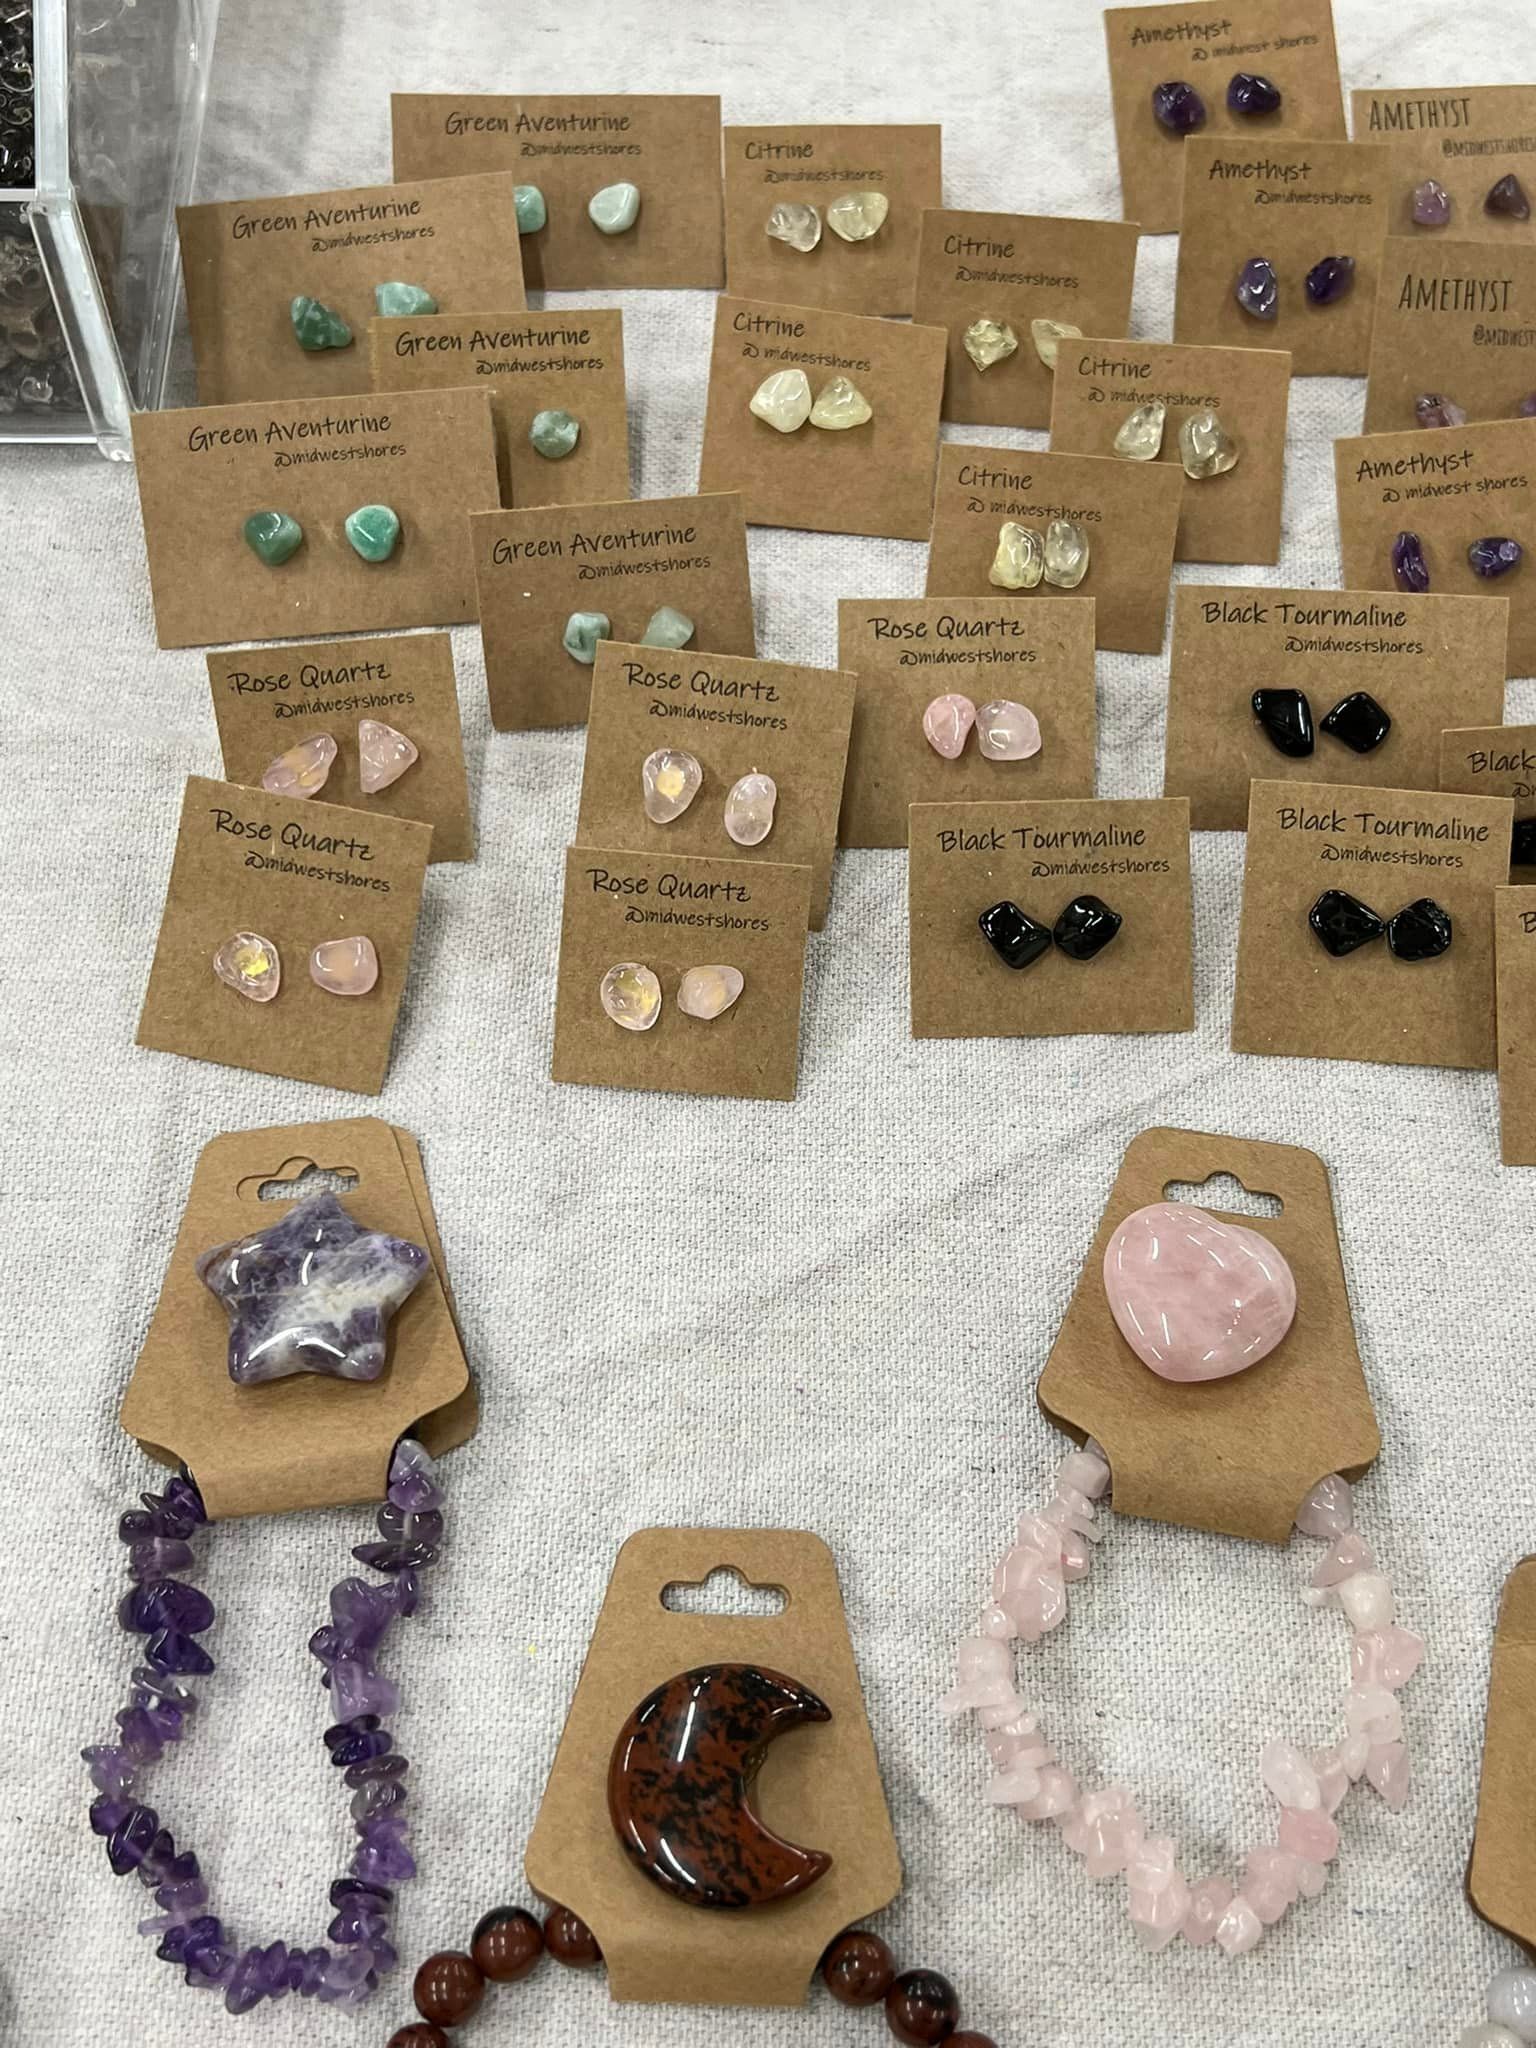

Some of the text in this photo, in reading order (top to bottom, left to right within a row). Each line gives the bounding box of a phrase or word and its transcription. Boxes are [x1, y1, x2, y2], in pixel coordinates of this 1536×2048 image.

[1131, 19, 1232, 46] Amethyst
[1192, 48, 1208, 61] @
[445, 111, 630, 135] Green Aventurine
[1369, 98, 1470, 131] AMETHYST
[521, 142, 641, 157] @midwestshores
[745, 141, 814, 160] Citrine
[1209, 159, 1312, 181] Amethyst
[1254, 190, 1373, 205] @midwestshores
[232, 198, 421, 240] Green Aventurine
[311, 224, 435, 252] @midwestshores
[944, 236, 1015, 258] Citrine
[955, 266, 1079, 289] @midwestshores
[1398, 274, 1512, 312] AMETHYST
[733, 312, 806, 337] Citrine
[396, 327, 590, 356] Green Aventurine
[476, 356, 603, 376] @midwestshores
[742, 343, 871, 372] @ midwestshores
[1078, 356, 1152, 379] Citrine
[189, 412, 392, 452] Green Aventurine
[274, 442, 406, 468] @midwestshores
[1356, 450, 1474, 482] Amethyst
[959, 466, 1033, 490] Citrine
[1382, 475, 1528, 503] @ midwest shores
[493, 525, 697, 565] Green Aventurine
[578, 555, 711, 580] @midwestshores
[867, 615, 1025, 639] Rose Quartz
[1201, 602, 1407, 628] Black Tourmaline
[900, 647, 1037, 666] @midwestshores
[1284, 636, 1424, 654] @midwestshores
[227, 661, 392, 696] Rose Quartz
[621, 661, 780, 702] Rose Quartz
[275, 690, 415, 719] @midwestshores
[649, 700, 787, 731] @midwestshores
[1467, 748, 1536, 774] Black
[209, 807, 375, 861] Rose Quartz
[1276, 807, 1489, 842] Black Tourmaline
[937, 824, 1146, 852] Black Tourmaline
[1032, 859, 1170, 878] @midwestshores
[1320, 844, 1463, 869] @midwestshores
[243, 851, 391, 893] @midwestshores
[586, 868, 751, 903] Rose Quartz
[625, 907, 770, 931] @midwestshores
